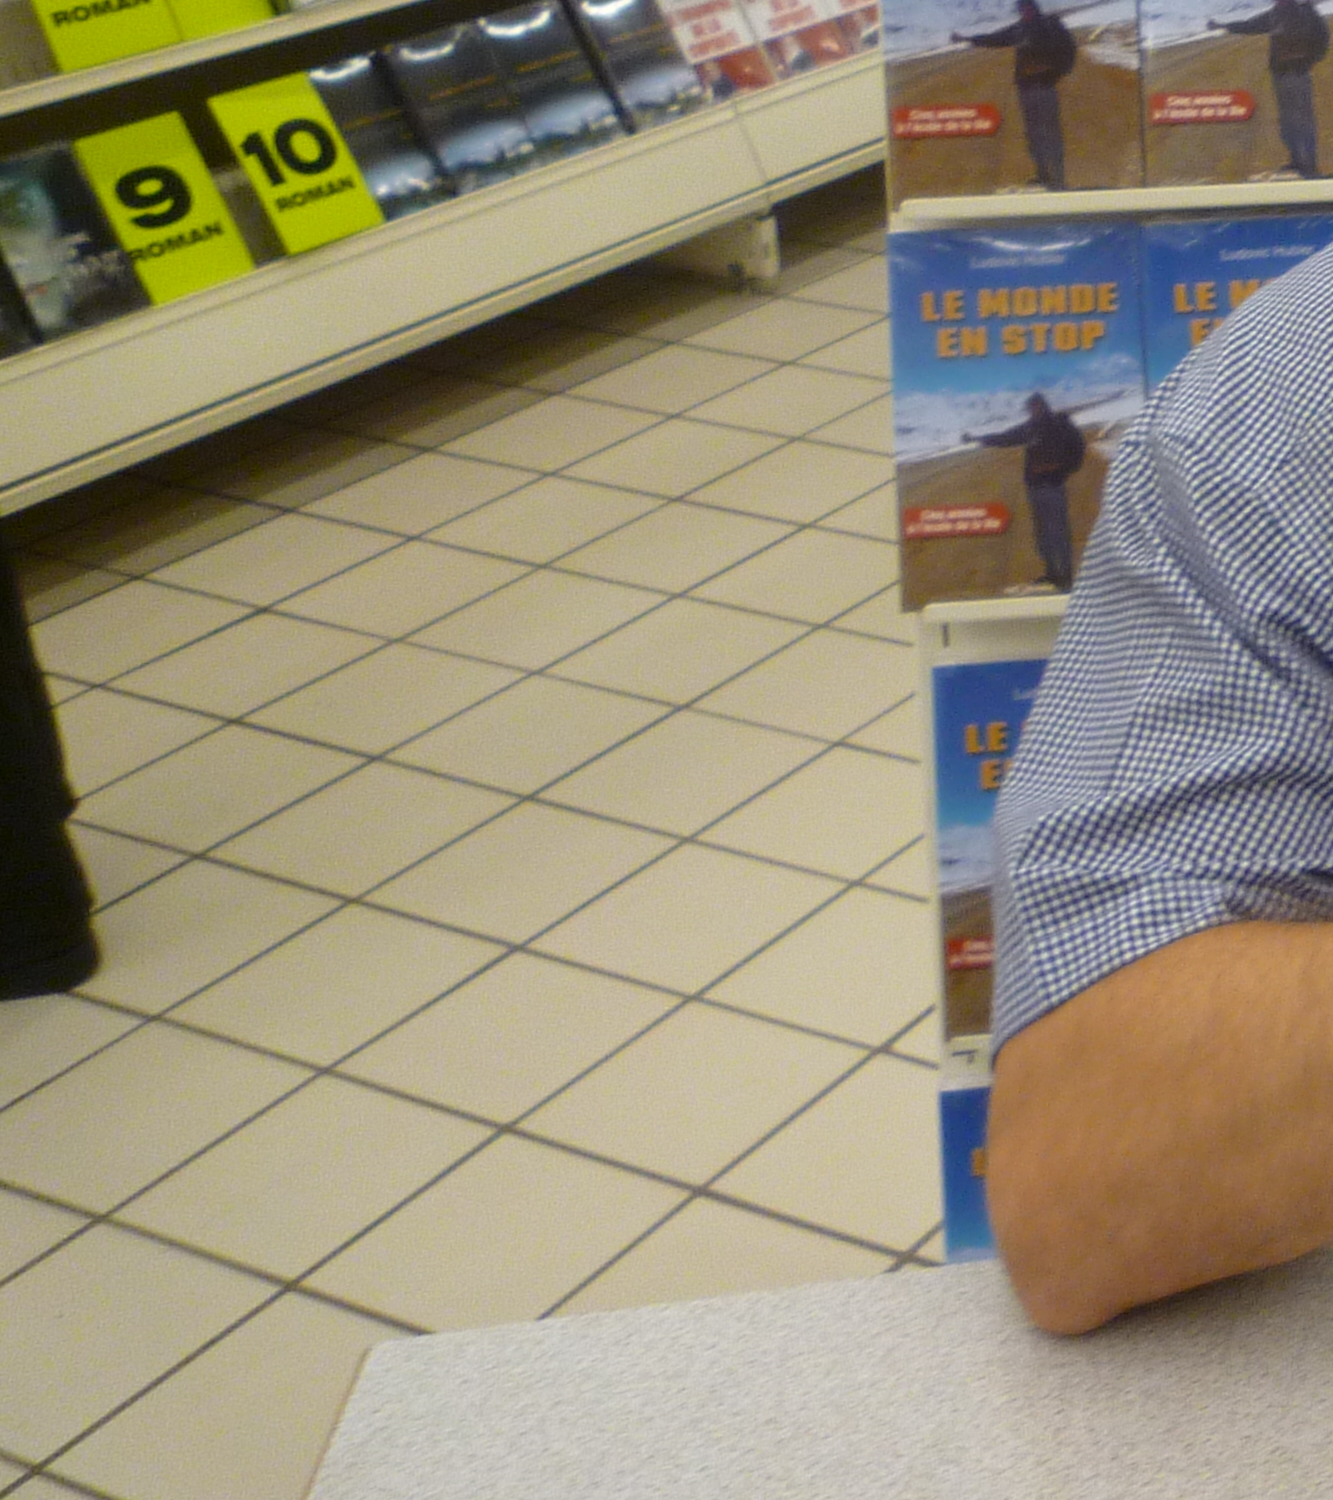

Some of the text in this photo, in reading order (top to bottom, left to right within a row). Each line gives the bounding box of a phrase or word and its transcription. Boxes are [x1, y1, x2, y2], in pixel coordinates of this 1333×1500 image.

[241, 119, 337, 186] 10
[115, 166, 191, 229] 9
[272, 173, 354, 211] ROMAN
[127, 218, 222, 265] ROMAN
[922, 284, 1115, 321] LE MONDE
[938, 321, 1104, 356] EN STOP
